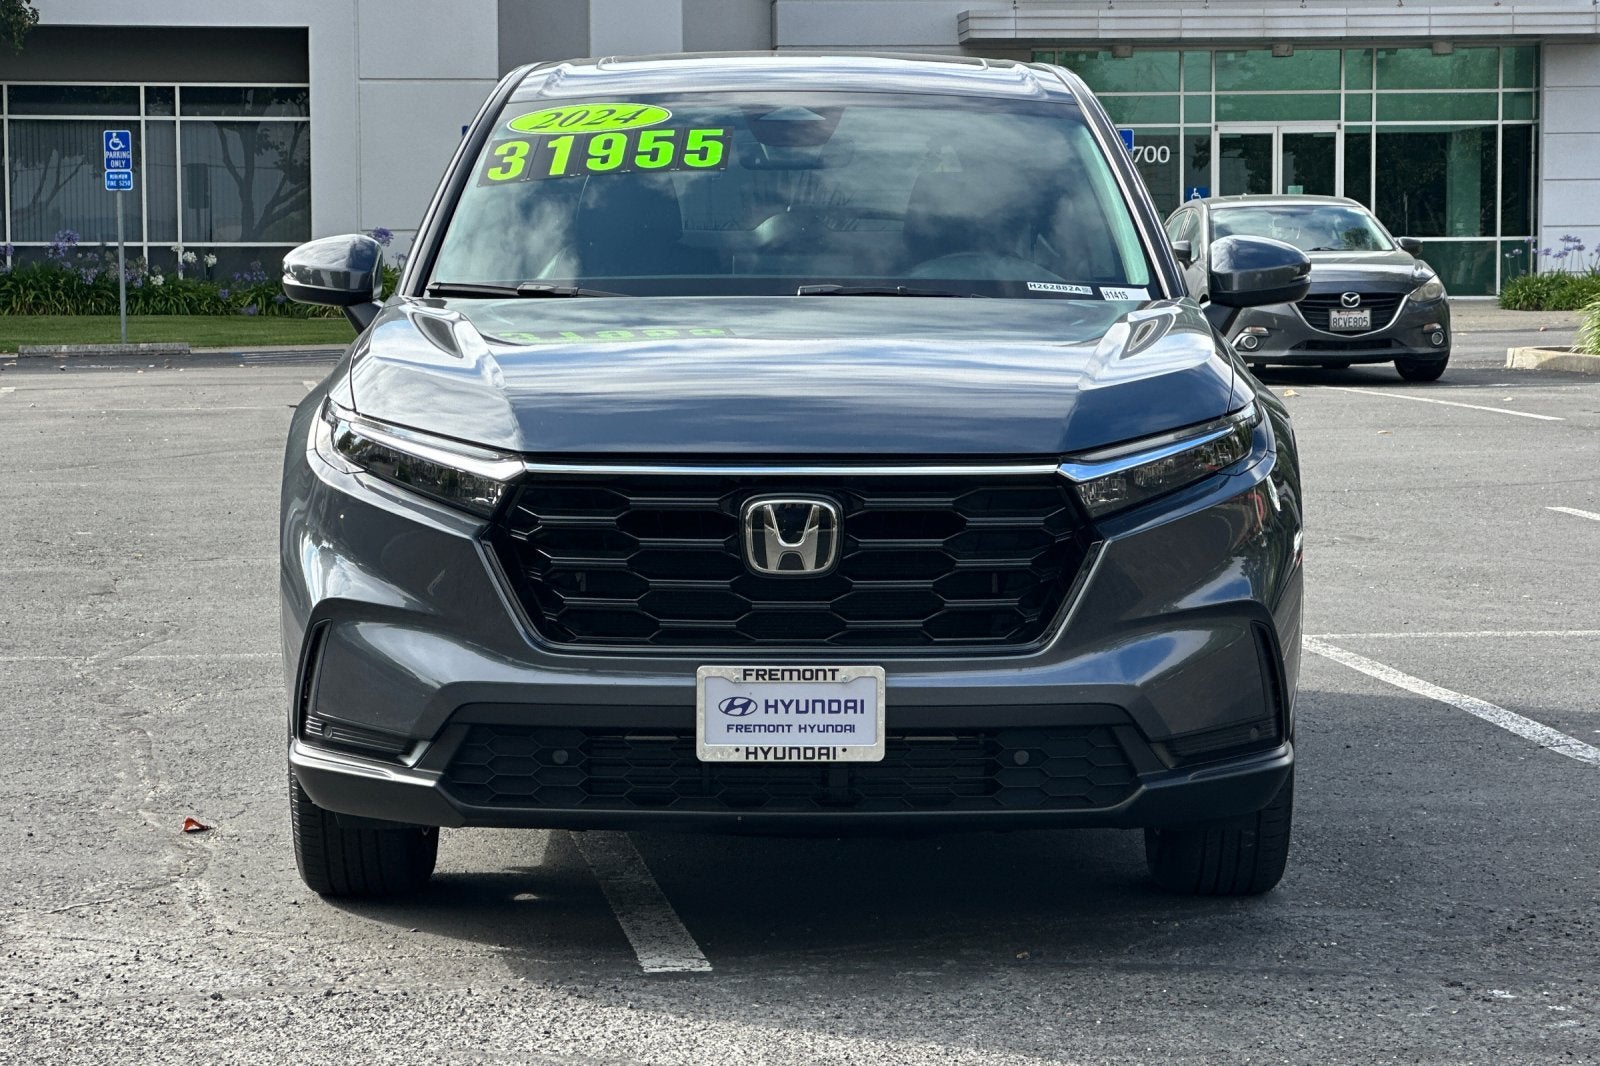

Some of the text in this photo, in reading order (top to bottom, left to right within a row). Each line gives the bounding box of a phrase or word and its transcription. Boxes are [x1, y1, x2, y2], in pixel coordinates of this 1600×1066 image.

[528, 107, 650, 130] 2024
[105, 150, 131, 159] PARKING
[487, 129, 724, 181] 31955
[110, 159, 126, 168] ONLY
[1103, 290, 1129, 300] H1415
[742, 668, 839, 681] FREMONT
[764, 699, 865, 714] HYUNDAI
[726, 724, 856, 733] FREMONT HYUNDAI
[745, 746, 837, 760] HYUNDAI
